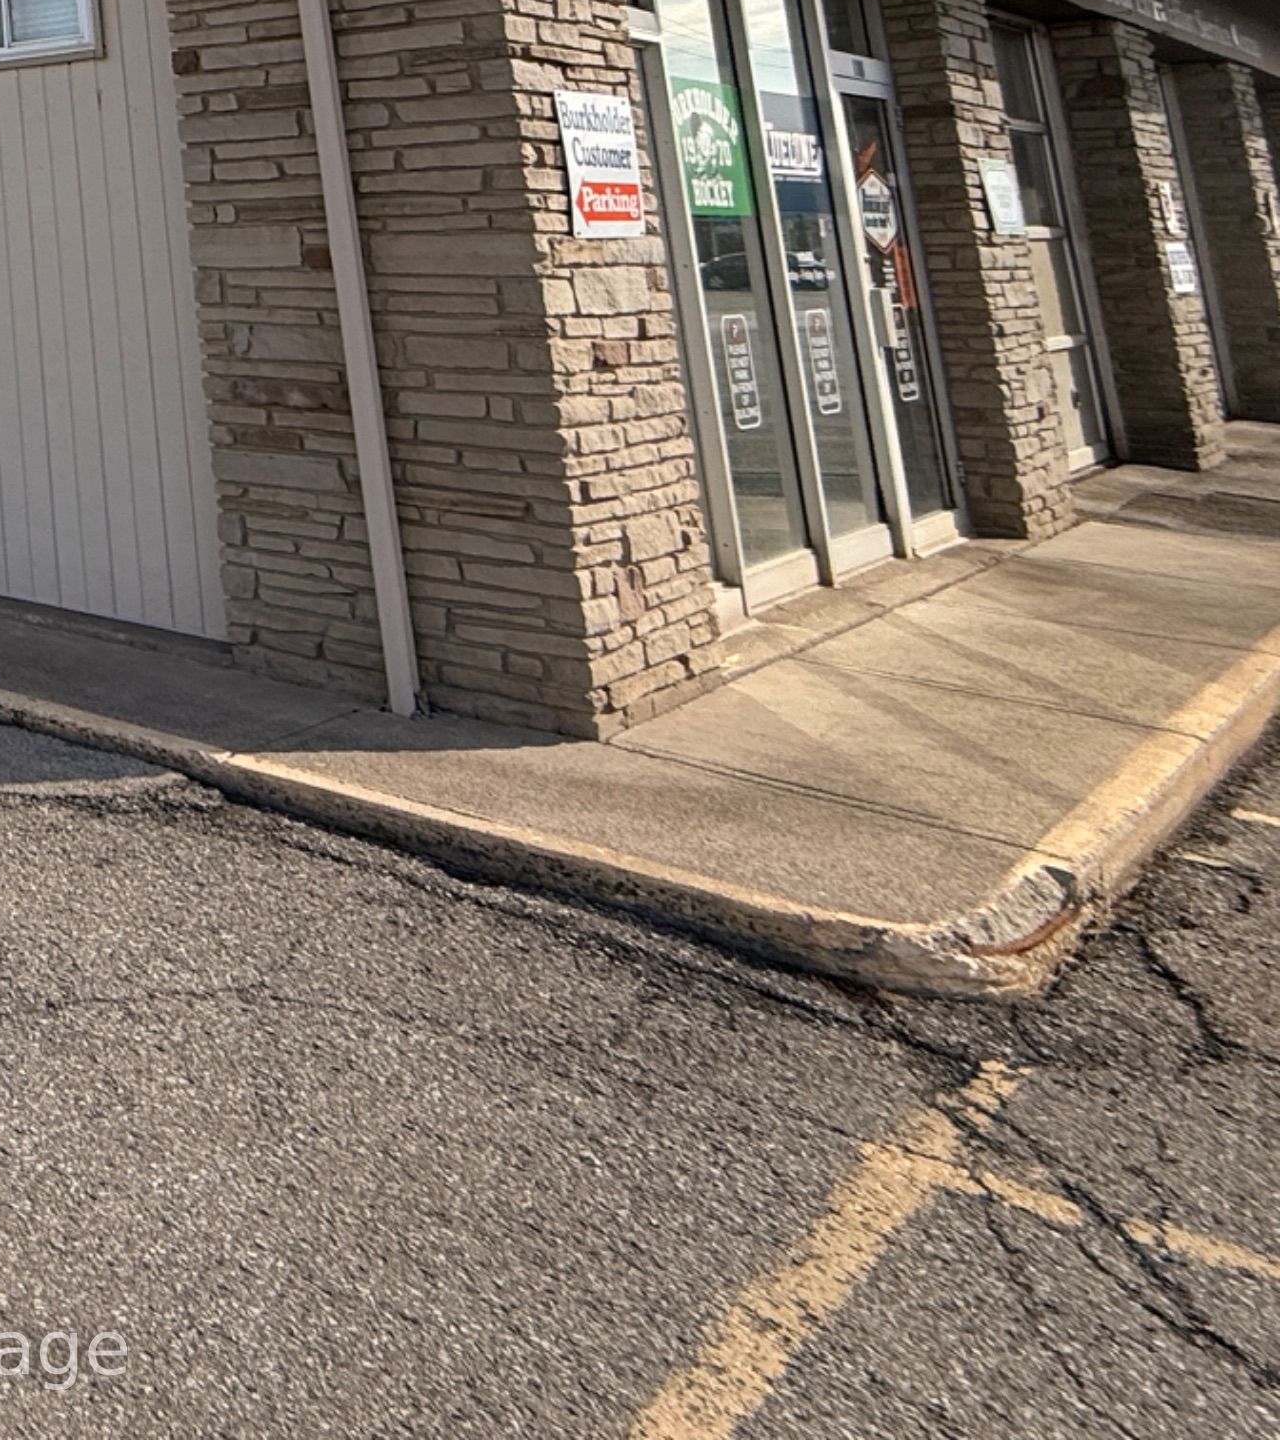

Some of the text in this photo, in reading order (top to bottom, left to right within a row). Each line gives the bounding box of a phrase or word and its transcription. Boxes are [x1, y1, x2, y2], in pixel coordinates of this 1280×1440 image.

[559, 101, 631, 135] Burkholder
[572, 137, 632, 169] Customer
[582, 185, 639, 218] Parking
